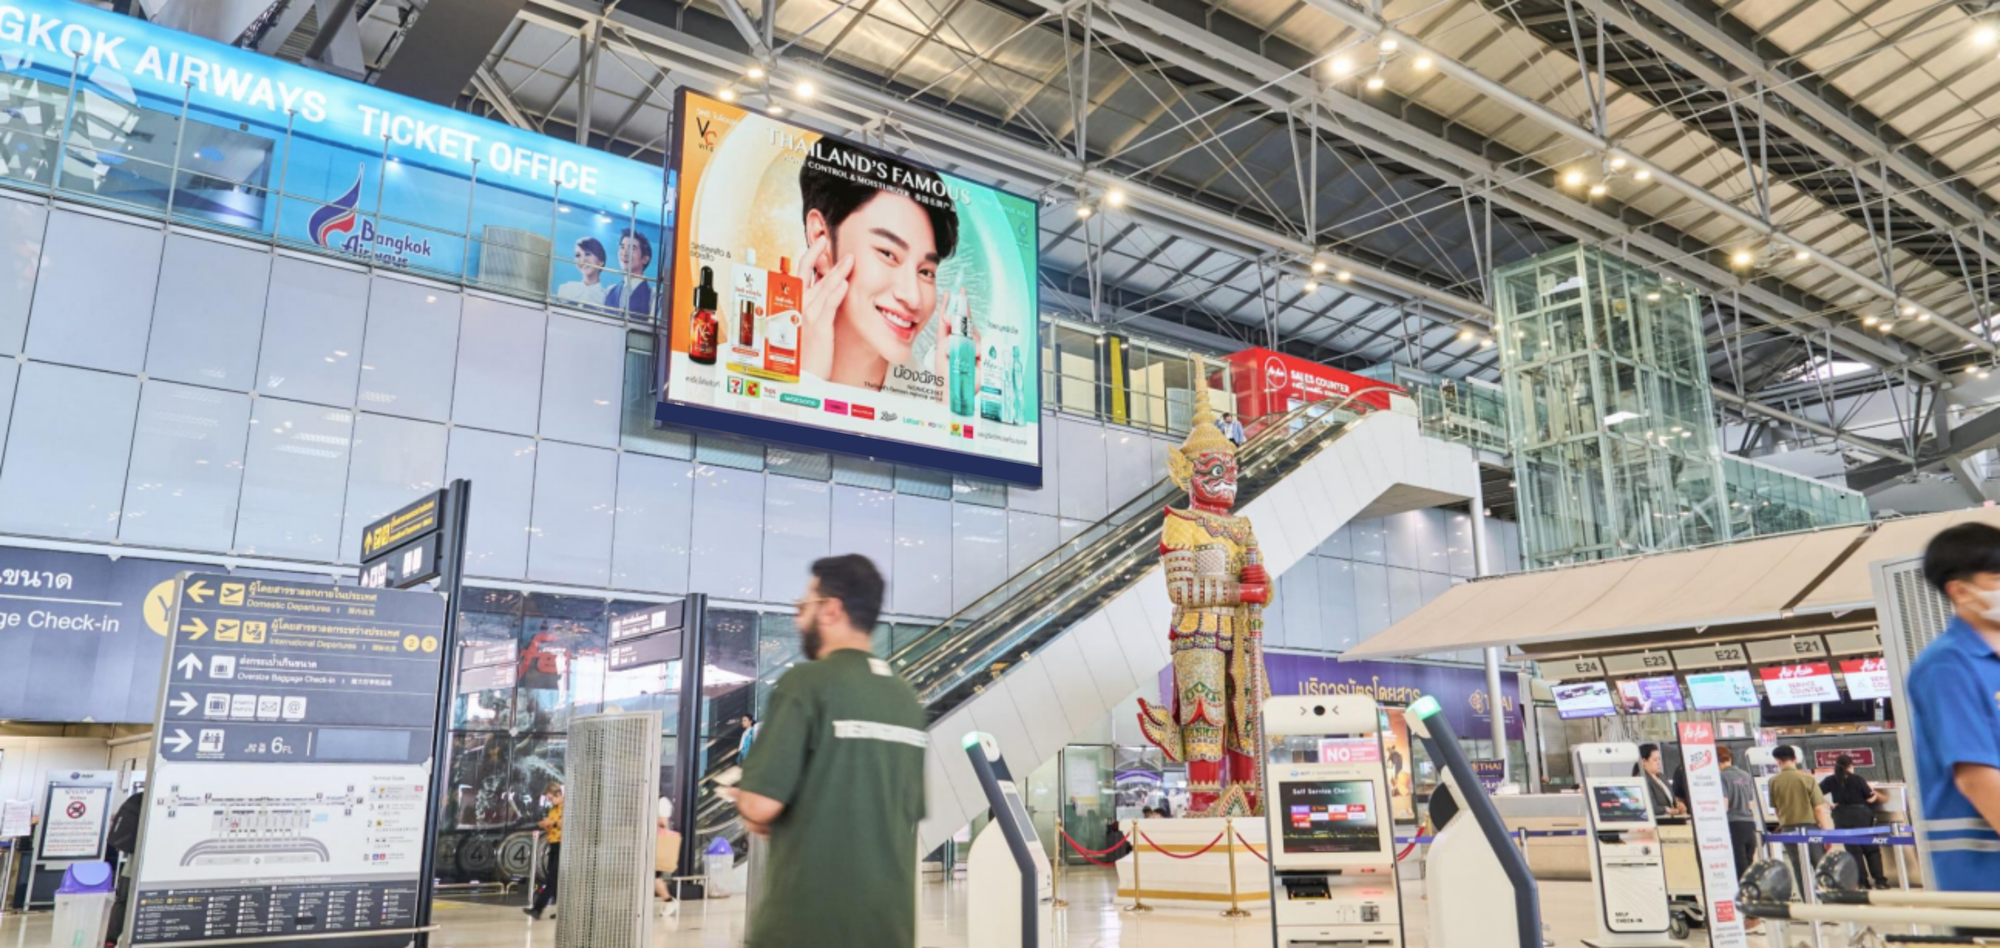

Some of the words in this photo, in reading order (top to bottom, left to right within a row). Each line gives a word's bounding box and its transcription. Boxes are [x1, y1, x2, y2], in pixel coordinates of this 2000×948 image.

[134, 45, 328, 124] AIRWAYS
[357, 104, 481, 163] TICKET
[488, 142, 599, 196] OFFICE
[767, 126, 888, 179] THAILAND'S
[892, 167, 972, 206] FAMOUS
[808, 161, 849, 181] CONTROL
[857, 176, 911, 198] MOISTURIZER
[361, 218, 431, 257] Bangkok
[1290, 369, 1315, 384] SALES
[1315, 376, 1351, 394] COUNTER
[784, 393, 816, 406] watsons
[0, 567, 73, 590] ขนาด
[246, 599, 285, 611] Domestic
[286, 602, 331, 615] Departures
[27, 609, 120, 633] Check-in
[269, 637, 315, 648] International
[316, 639, 358, 651] Departures
[408, 639, 415, 648] 2
[426, 640, 433, 648] 3
[1794, 641, 1820, 653] E21
[1643, 655, 1667, 667] E23
[1715, 649, 1741, 661] E22
[1575, 662, 1598, 673] E24
[237, 671, 270, 682] Oversize
[271, 673, 302, 684] Baggage
[304, 675, 336, 684] Check-in
[1787, 680, 1815, 688] SERVICE
[1790, 686, 1824, 695] COUNTER
[1483, 692, 1513, 712] TAI
[1326, 747, 1350, 762] NO
[1480, 762, 1502, 771] THAI
[1292, 787, 1306, 795] Self
[1307, 787, 1331, 795] Service
[513, 845, 526, 865] 4
